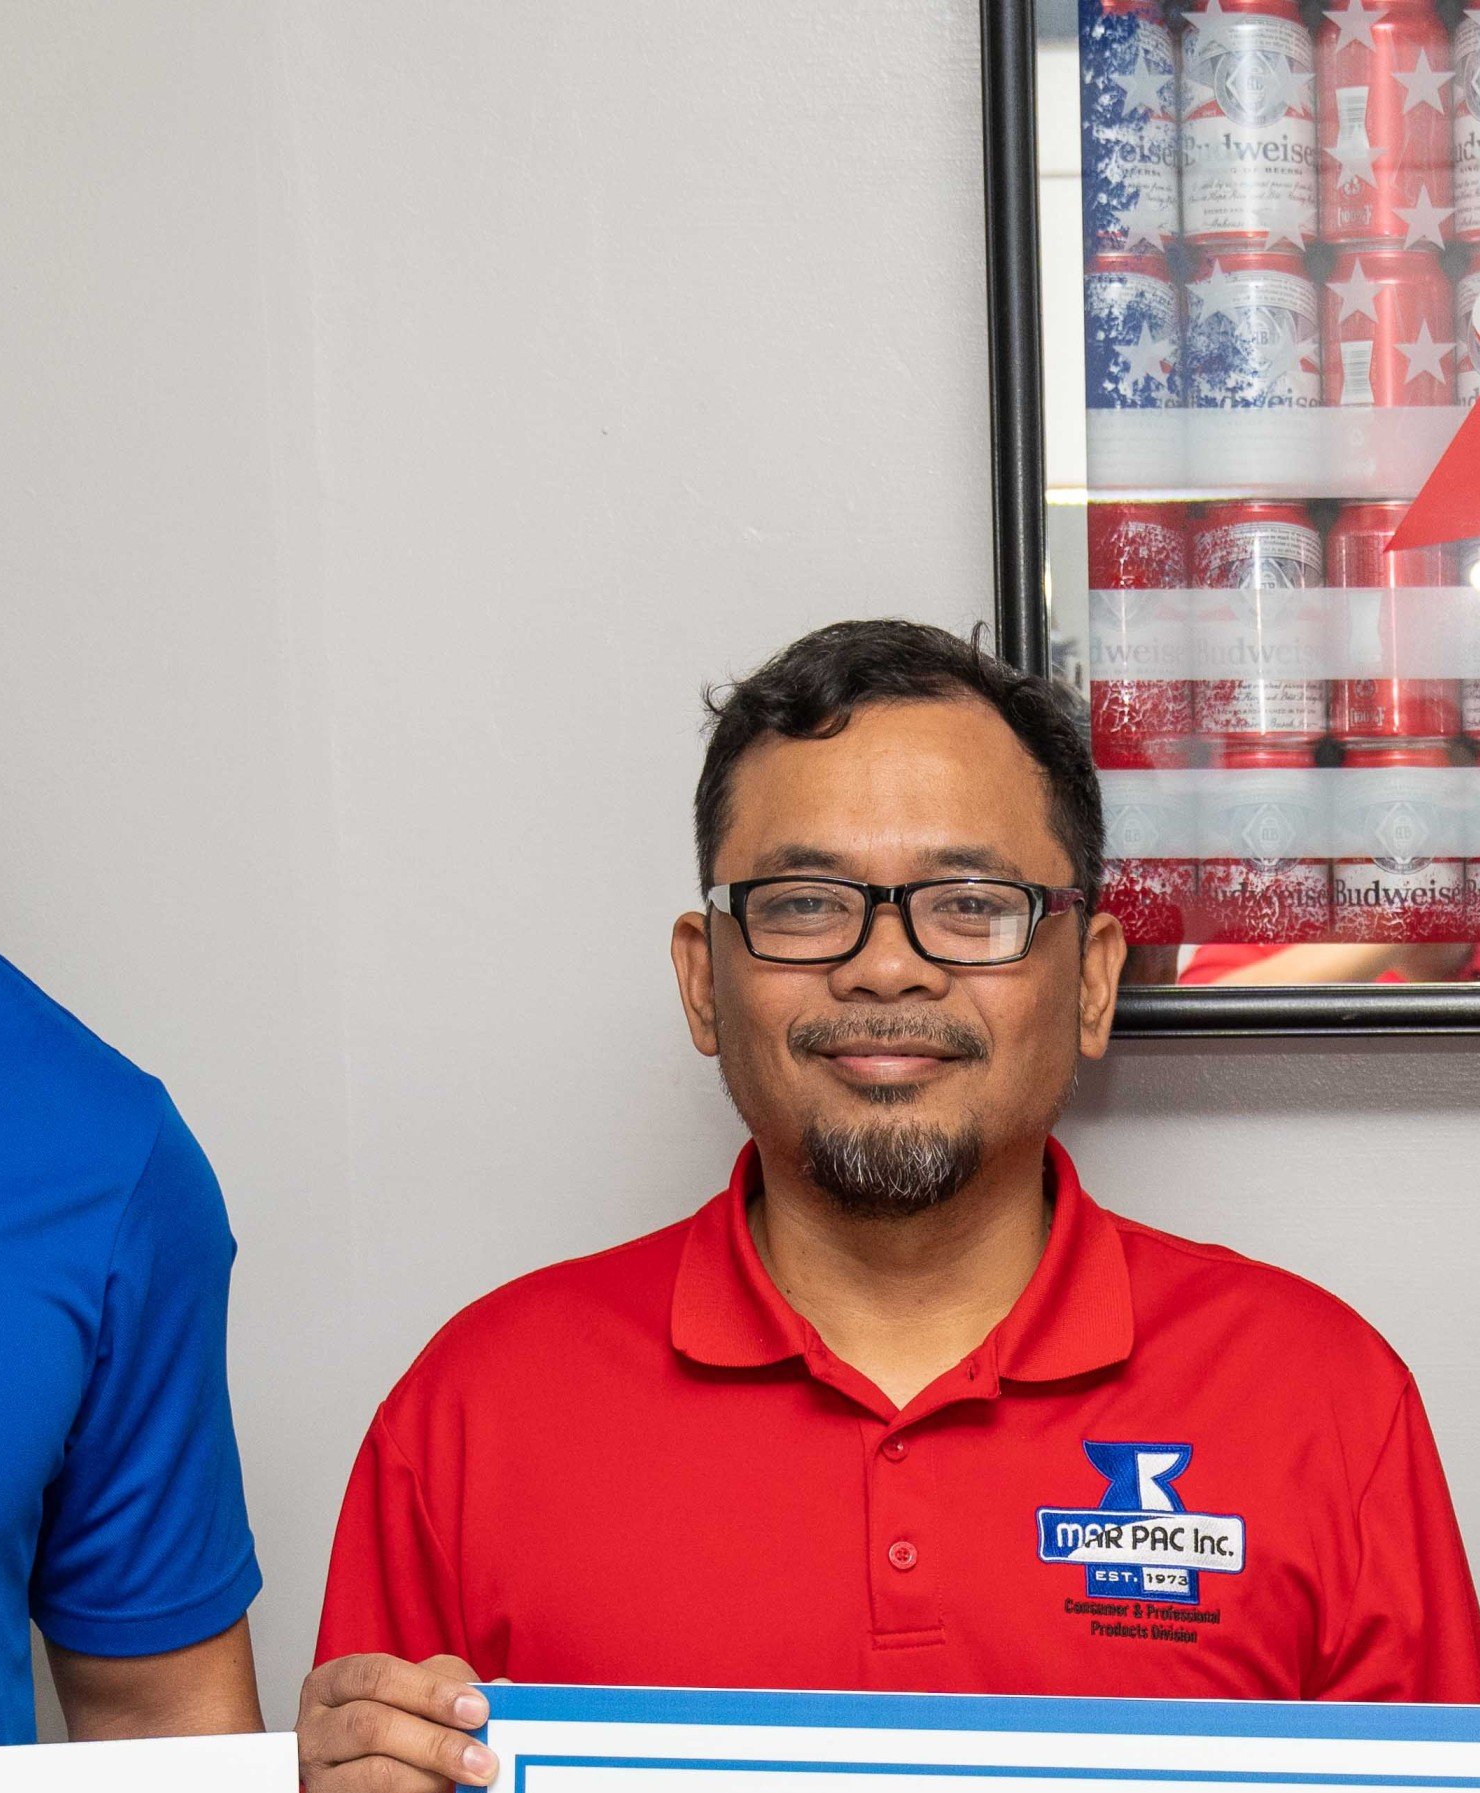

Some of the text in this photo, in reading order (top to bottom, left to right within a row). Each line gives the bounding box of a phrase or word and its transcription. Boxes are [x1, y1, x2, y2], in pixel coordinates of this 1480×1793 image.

[1132, 1525, 1185, 1552] PAC
[1193, 1528, 1235, 1557] Inc.
[1095, 1570, 1189, 1586] EST. 1973
[1065, 1599, 1220, 1625] Consumer & Professional
[1090, 1620, 1198, 1643] Products Division
